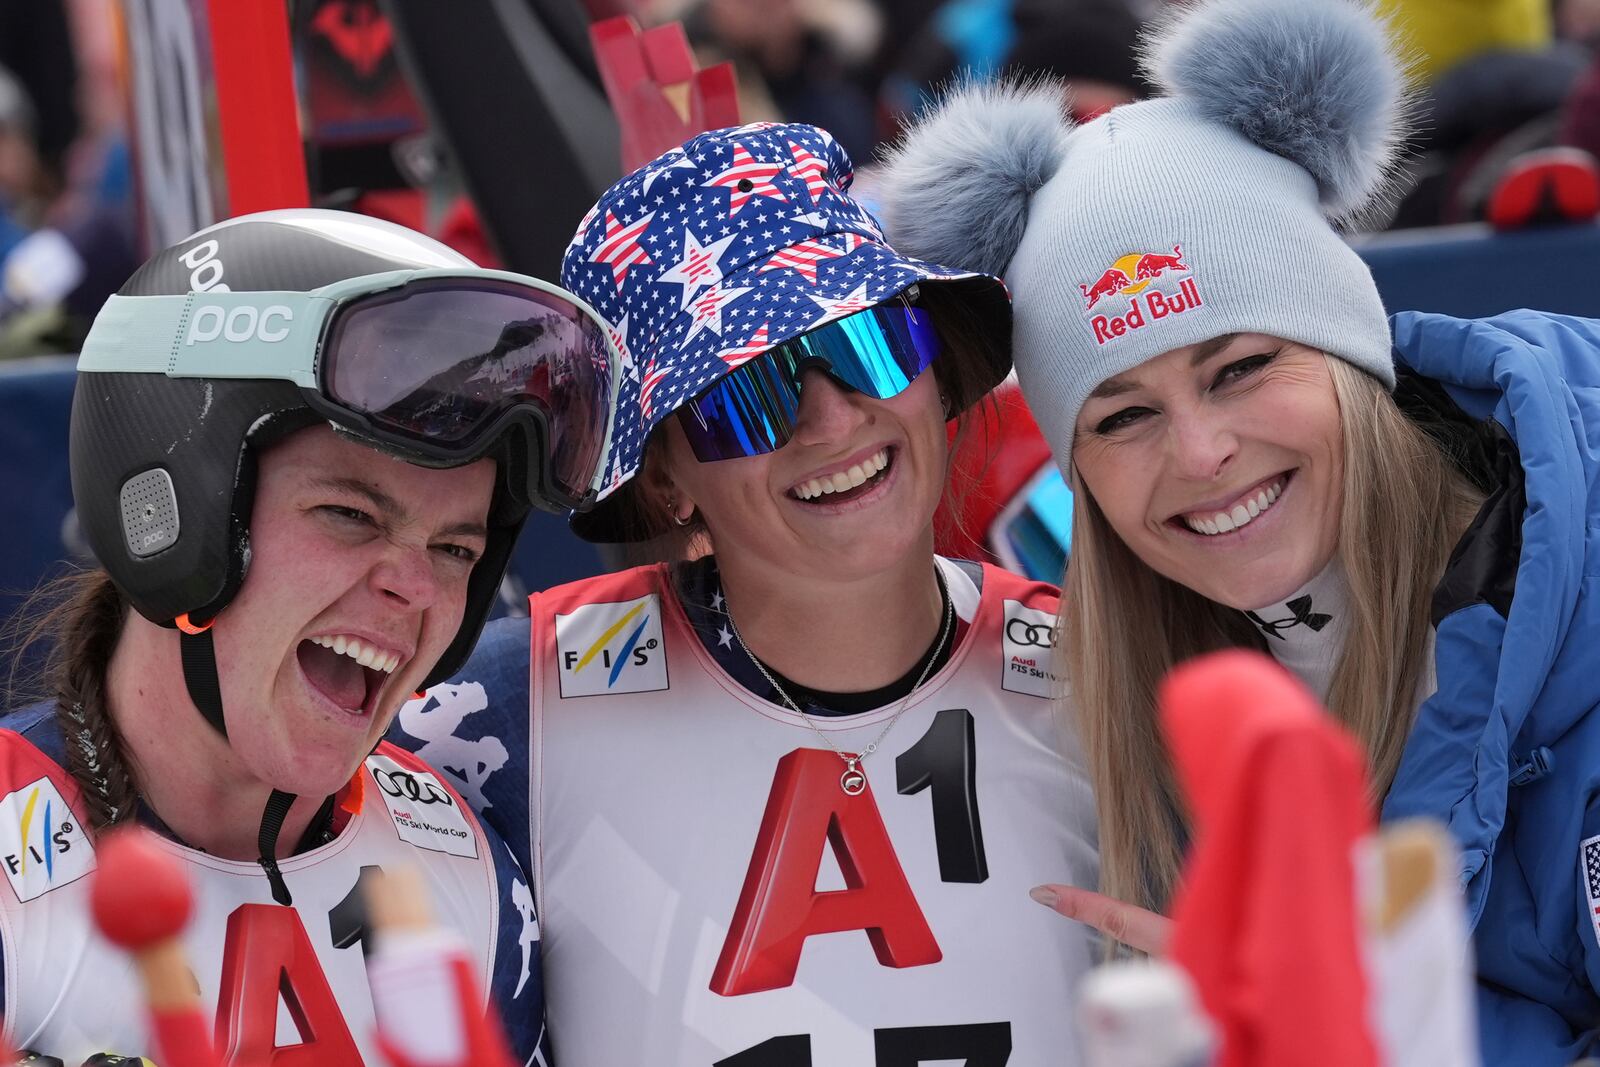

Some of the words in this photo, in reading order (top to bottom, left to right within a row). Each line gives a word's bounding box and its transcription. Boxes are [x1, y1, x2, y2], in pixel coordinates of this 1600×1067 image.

[1090, 298, 1146, 345] Red
[1145, 277, 1203, 320] Bull
[186, 304, 294, 346] poc
[1011, 655, 1036, 667] Audi
[1011, 662, 1028, 674] FIS
[1030, 668, 1045, 679] Ski
[393, 809, 412, 820] Audi
[410, 820, 422, 830] Ski
[423, 822, 449, 836] World
[450, 828, 468, 839] Cup
[708, 708, 990, 997] A1
